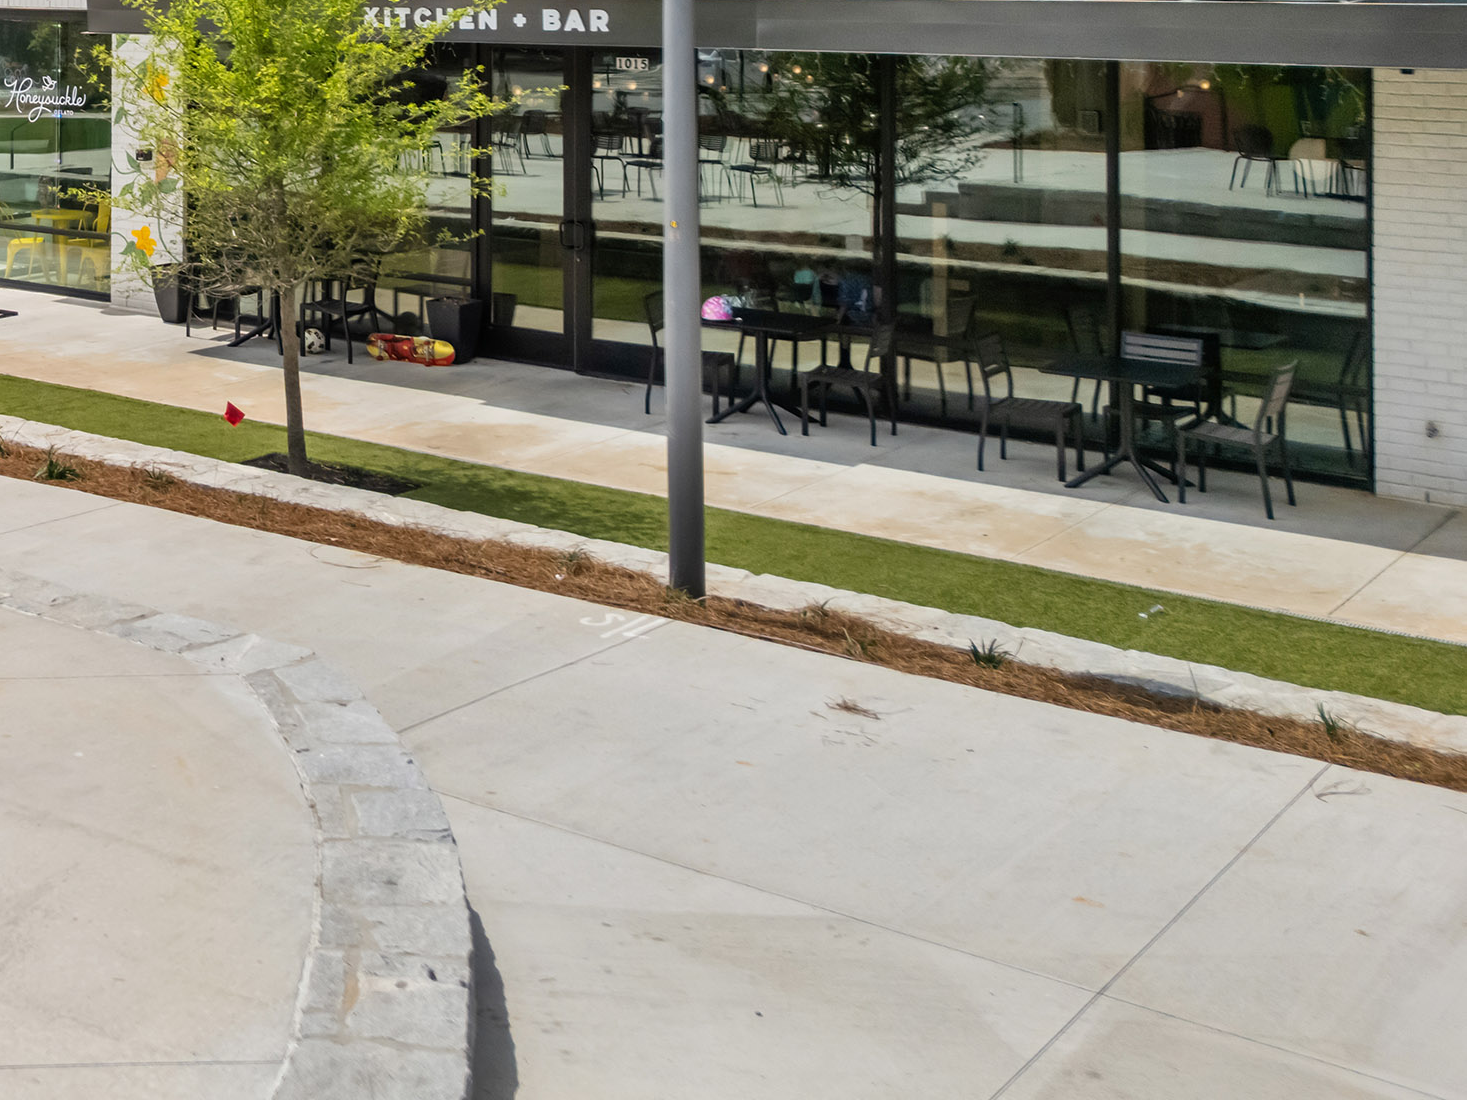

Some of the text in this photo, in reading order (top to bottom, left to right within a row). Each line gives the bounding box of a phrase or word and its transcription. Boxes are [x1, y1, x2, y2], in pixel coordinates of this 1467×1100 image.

[363, 6, 497, 30] KITCHEN
[542, 9, 610, 32] BAR
[618, 58, 648, 69] 1015
[4, 77, 87, 122] Honeysuckle
